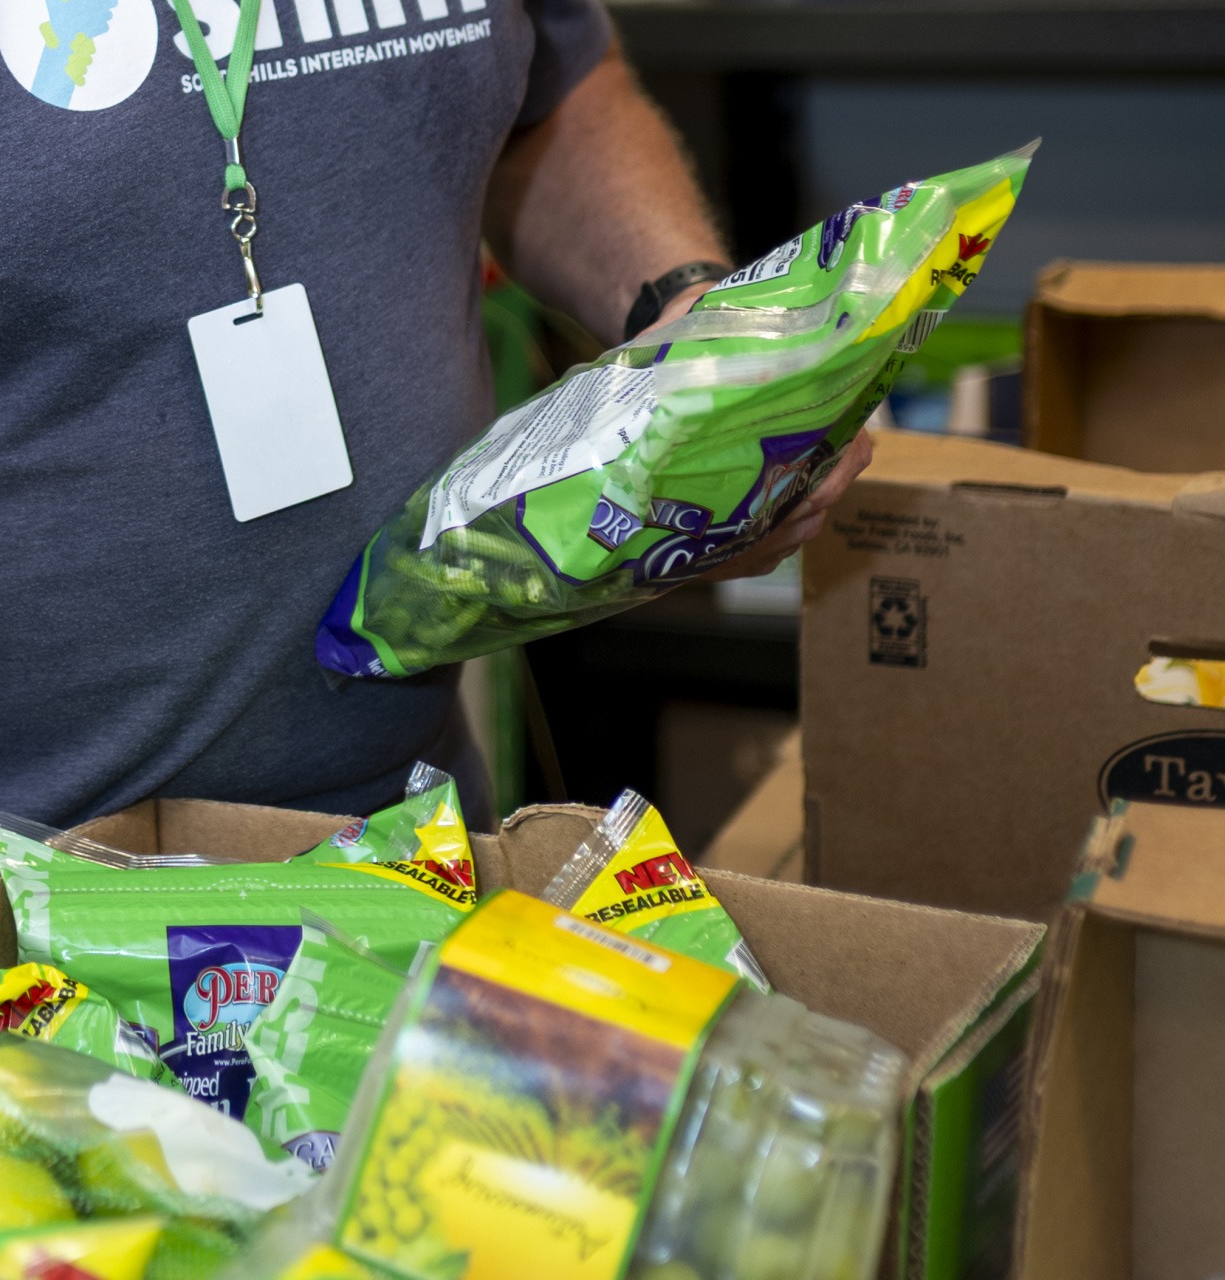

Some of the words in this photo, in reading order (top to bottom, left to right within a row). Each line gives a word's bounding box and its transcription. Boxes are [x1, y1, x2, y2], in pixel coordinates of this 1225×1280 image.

[301, 37, 406, 75] INTERFAITH
[410, 18, 492, 54] MOVEMENT
[585, 884, 703, 924] RESEALABLE
[195, 965, 280, 1030] PER
